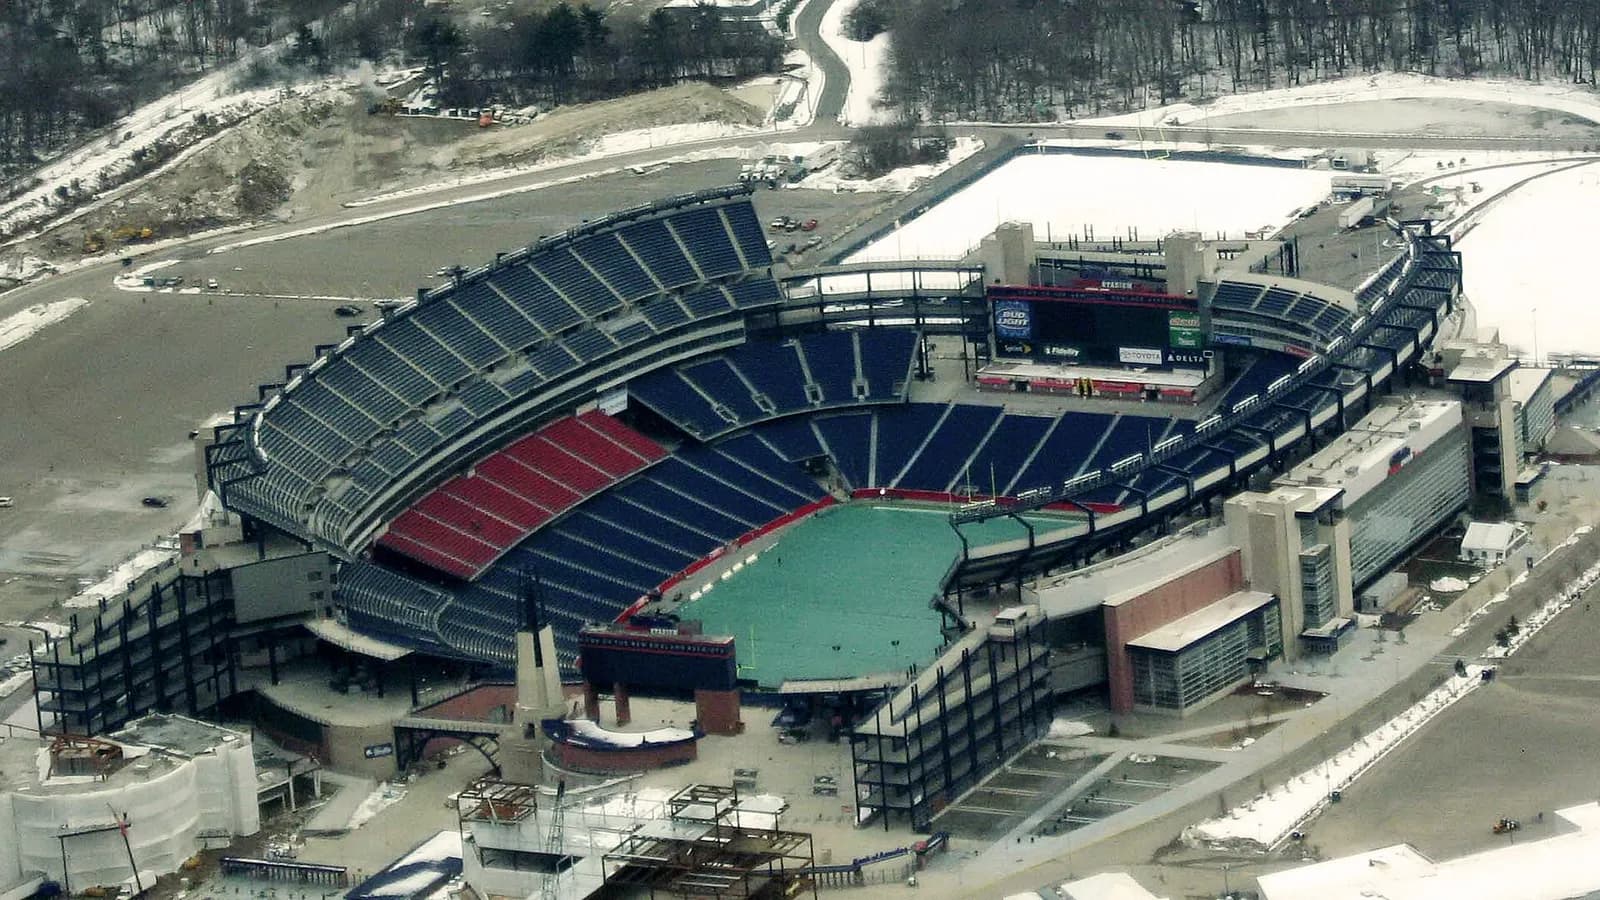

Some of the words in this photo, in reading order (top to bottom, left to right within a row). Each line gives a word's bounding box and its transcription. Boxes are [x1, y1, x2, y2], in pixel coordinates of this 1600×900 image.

[1002, 310, 1026, 319] BUD
[996, 318, 1029, 326] LIGHT
[1051, 346, 1080, 357] Fidelity
[1132, 351, 1160, 360] TOYOTA
[1175, 355, 1204, 363] DELTA
